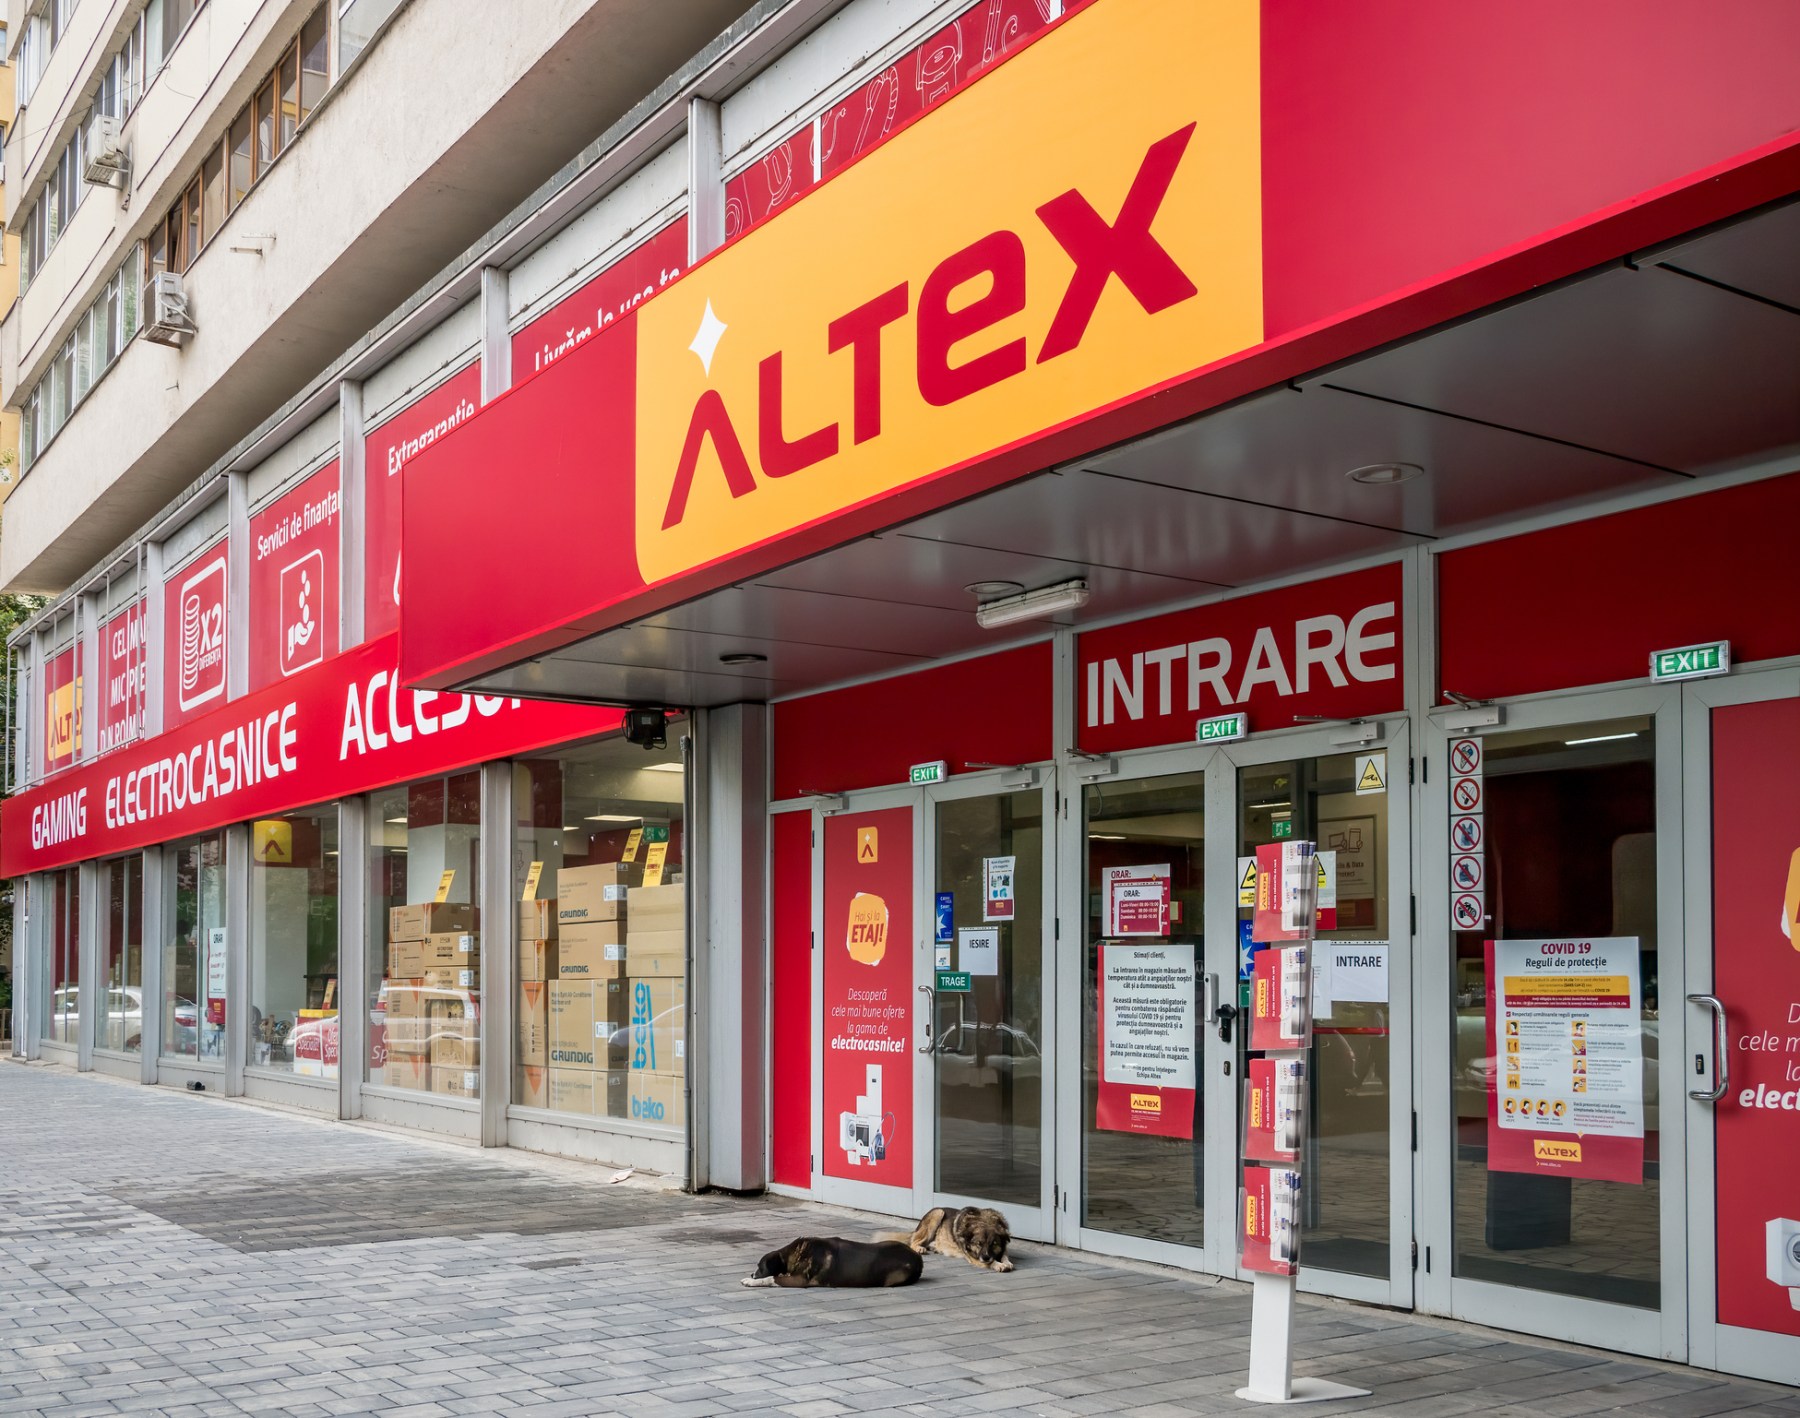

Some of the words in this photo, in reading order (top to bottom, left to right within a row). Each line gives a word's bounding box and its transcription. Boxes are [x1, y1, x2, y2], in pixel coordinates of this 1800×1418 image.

[257, 516, 289, 560] Servicii
[290, 511, 302, 540] de
[1087, 601, 1395, 727] INTRARE
[1660, 648, 1714, 674] EXIT
[110, 672, 126, 708] MIC
[1202, 720, 1235, 738] EXIT
[32, 787, 87, 850] GAMING
[105, 701, 297, 829] ELECTROCASNICE
[912, 766, 937, 782] EXIT
[1111, 870, 1131, 878] ORAR:
[560, 909, 588, 919] GRUNDIG
[851, 923, 884, 947] ETAJ!
[969, 939, 990, 949] IESIRE
[1541, 943, 1575, 955] COVID
[1578, 942, 1591, 954] 19
[561, 965, 589, 974] GRUNDIG
[1336, 956, 1382, 967] INTRARE
[1525, 958, 1552, 969] Reguli
[1555, 957, 1565, 967] de
[1567, 956, 1607, 969] protecție
[941, 976, 965, 987] TRAGE
[848, 988, 887, 1003] Descoperă
[1160, 998, 1187, 1006] obligatorie
[831, 1004, 846, 1017] cele
[847, 1006, 861, 1018] mai
[862, 1005, 881, 1019] bune
[882, 1005, 905, 1021] oferte
[632, 982, 647, 1069] beko
[847, 1021, 854, 1034] la
[855, 1024, 876, 1037] gama
[878, 1023, 888, 1035] de
[831, 1034, 906, 1053] electrocasnice!
[1738, 1030, 1779, 1052] cele
[551, 1050, 593, 1064] GRUNDIG
[632, 1094, 664, 1121] beko
